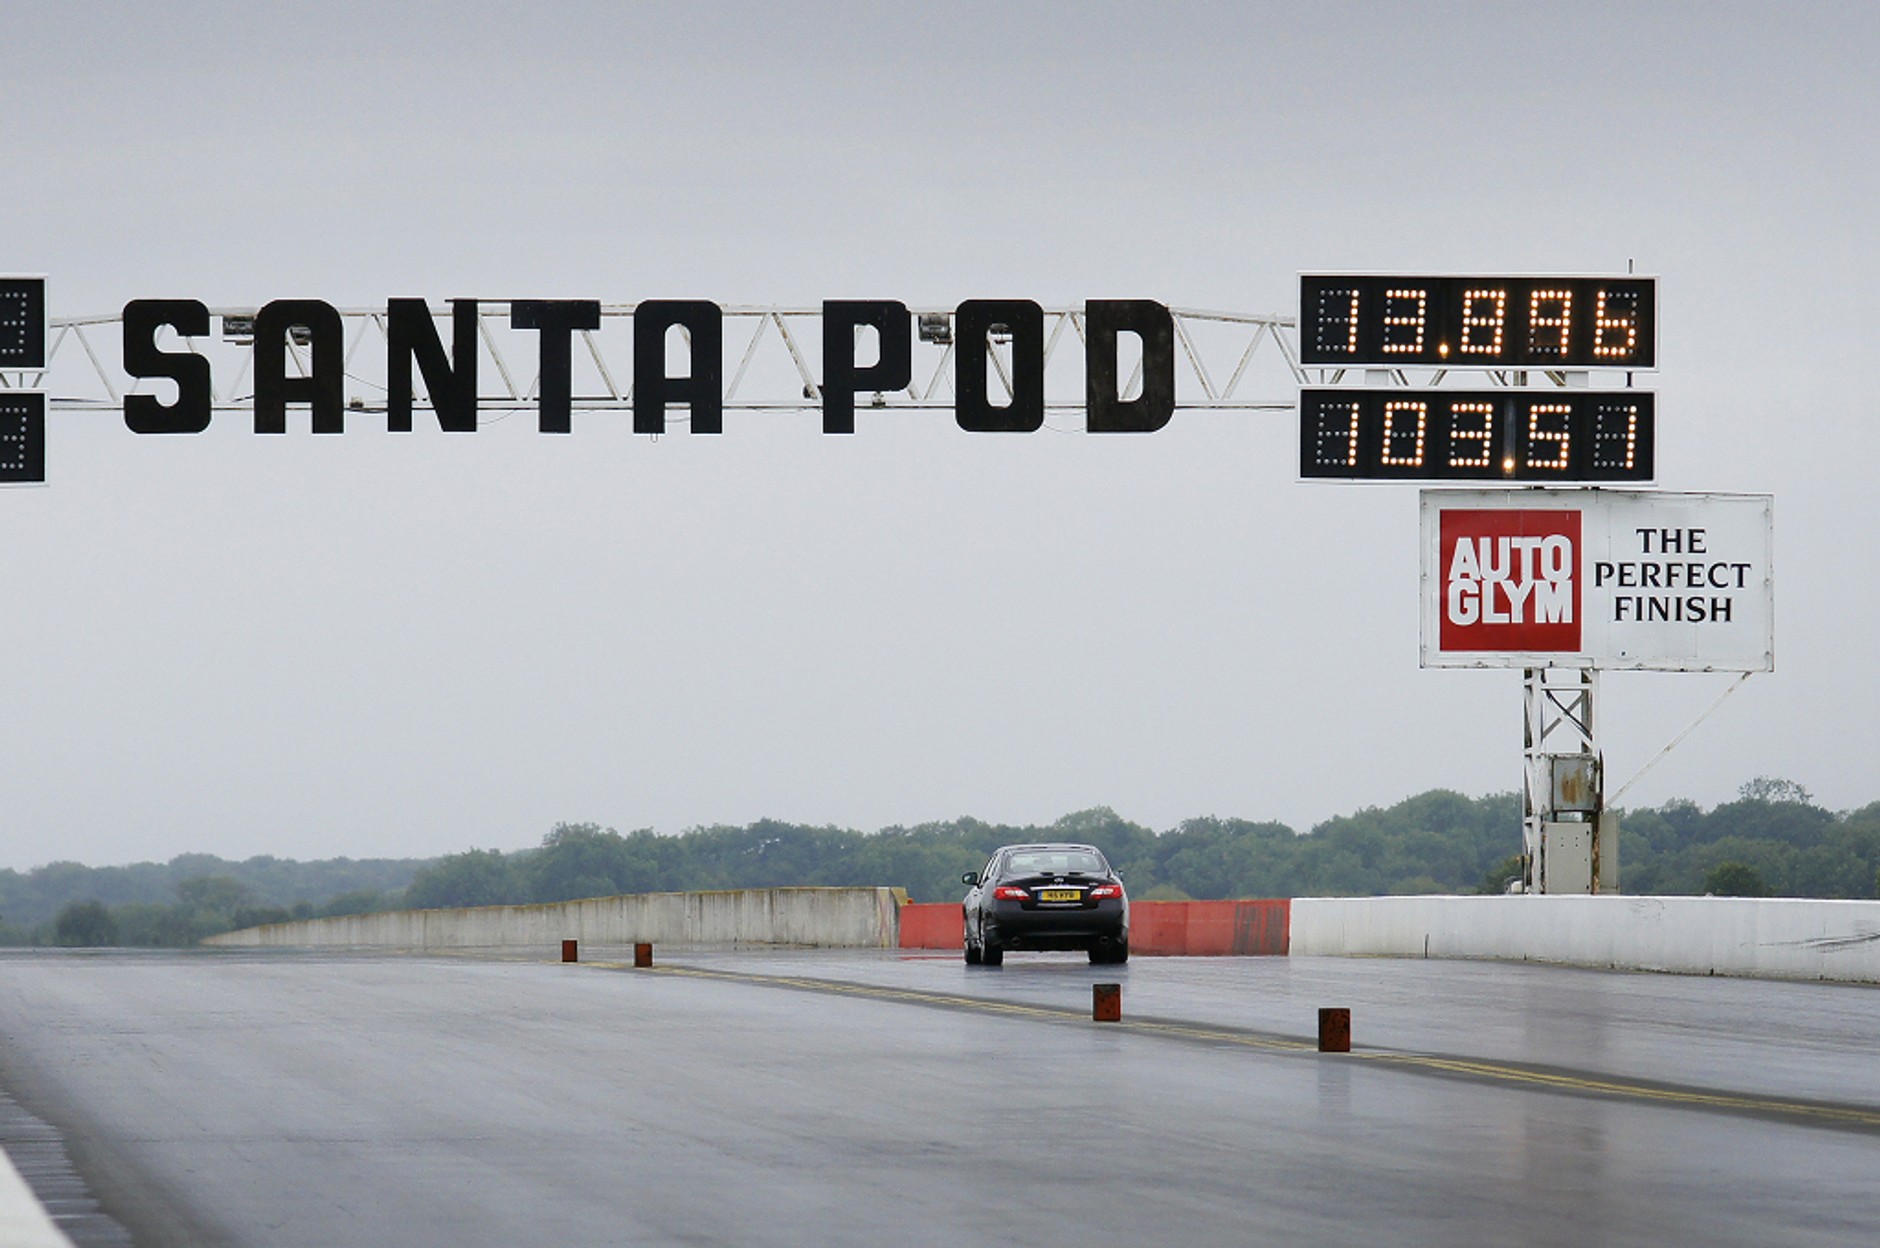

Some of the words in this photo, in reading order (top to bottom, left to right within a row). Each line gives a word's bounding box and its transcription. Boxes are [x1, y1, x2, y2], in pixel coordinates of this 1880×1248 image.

[1347, 289, 1637, 358] 13.896
[123, 297, 722, 434] SANTA
[823, 299, 1175, 433] POD
[1347, 400, 1639, 474] 103.51
[1448, 535, 1573, 582] AUTO
[1635, 528, 1708, 554] THE
[1594, 562, 1752, 589] PERFECT
[1448, 578, 1573, 625] GLYM
[1613, 596, 1733, 623] FINISH
